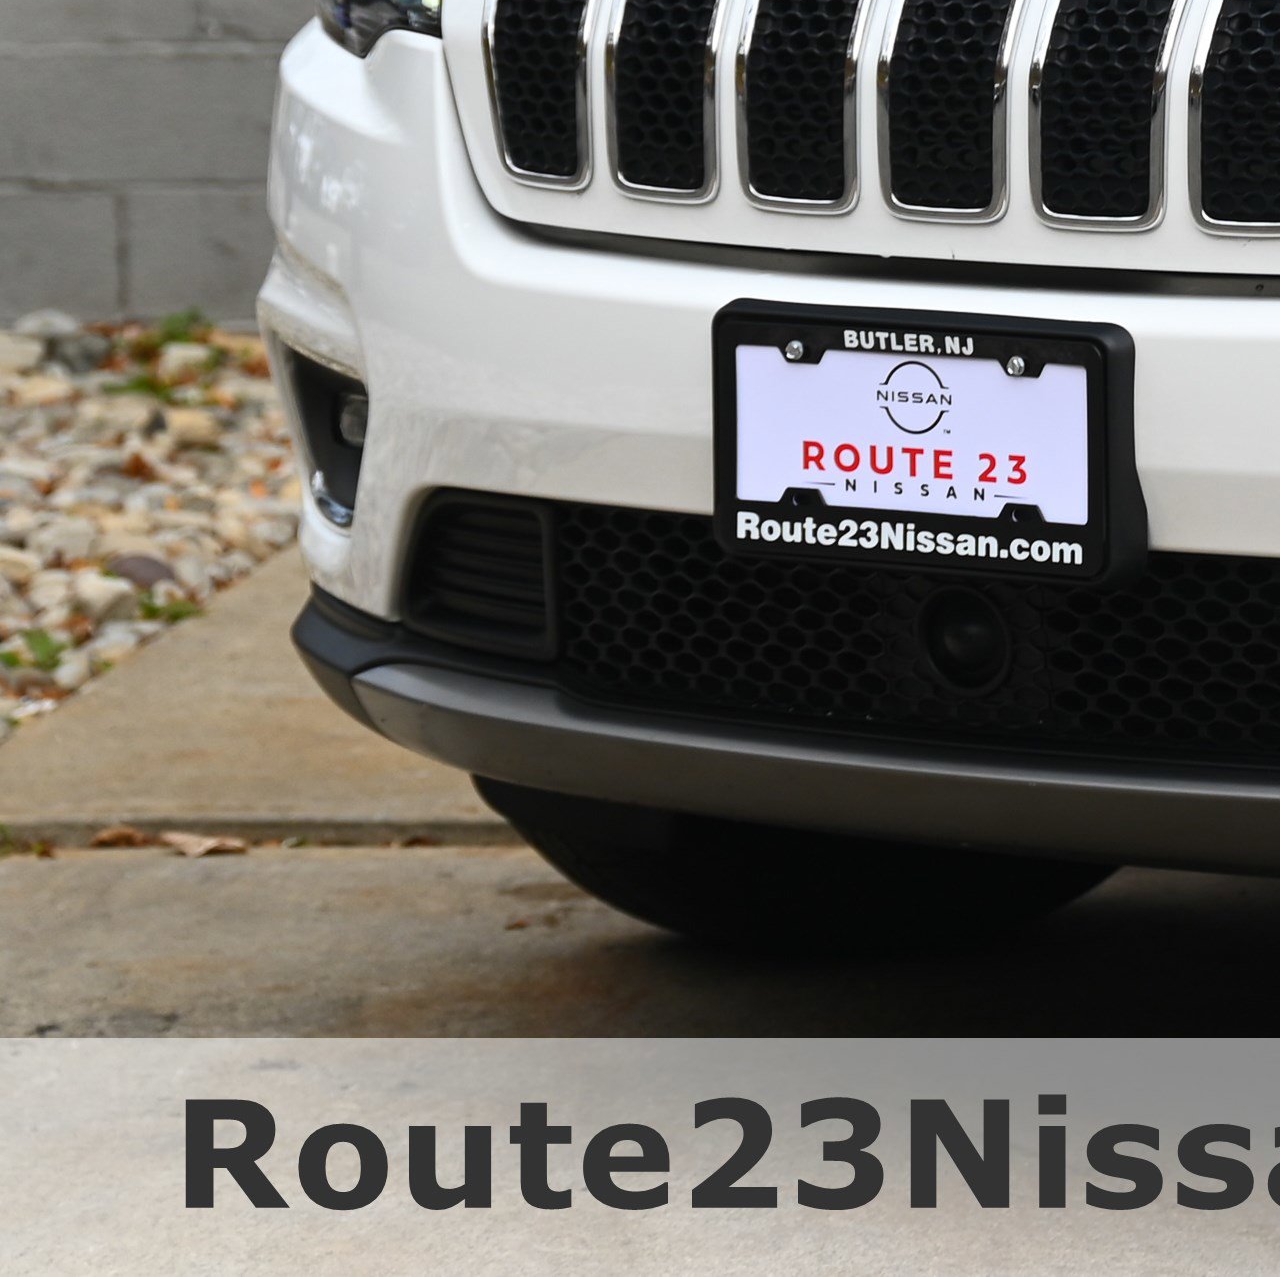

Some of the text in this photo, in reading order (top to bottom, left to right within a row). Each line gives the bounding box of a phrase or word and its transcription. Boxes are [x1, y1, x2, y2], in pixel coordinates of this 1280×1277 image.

[876, 389, 952, 407] NISSAN
[802, 439, 1028, 486] ROUTE 23
[845, 478, 986, 502] NISSAN
[736, 510, 1083, 565] Route23Nissan.com
